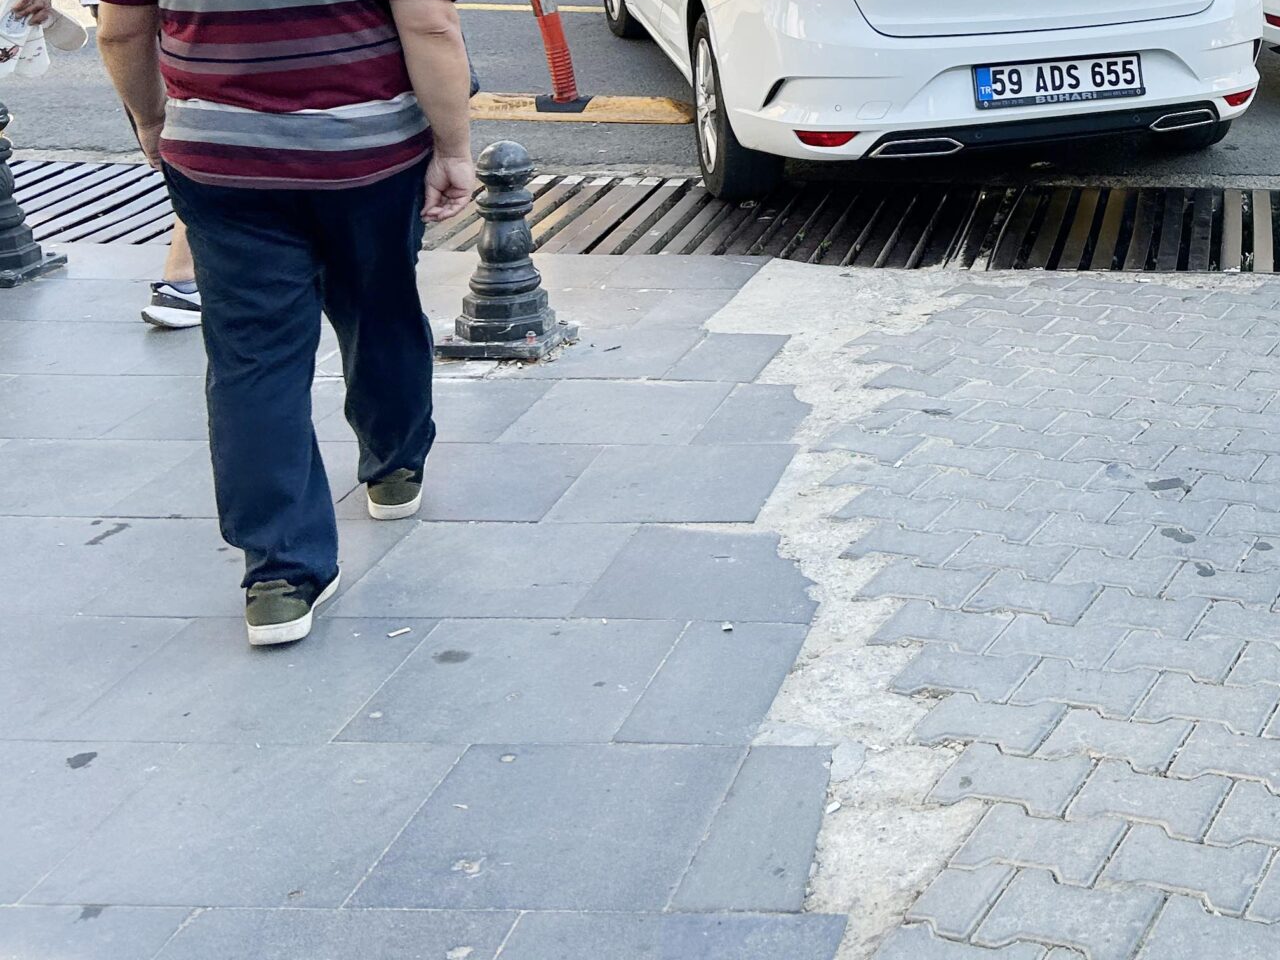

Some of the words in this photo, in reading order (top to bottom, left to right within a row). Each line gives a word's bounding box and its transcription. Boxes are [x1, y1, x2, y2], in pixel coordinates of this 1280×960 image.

[991, 68, 1023, 96] 59
[1035, 64, 1081, 93] ADS
[1090, 59, 1136, 88] 655
[980, 85, 992, 95] TR
